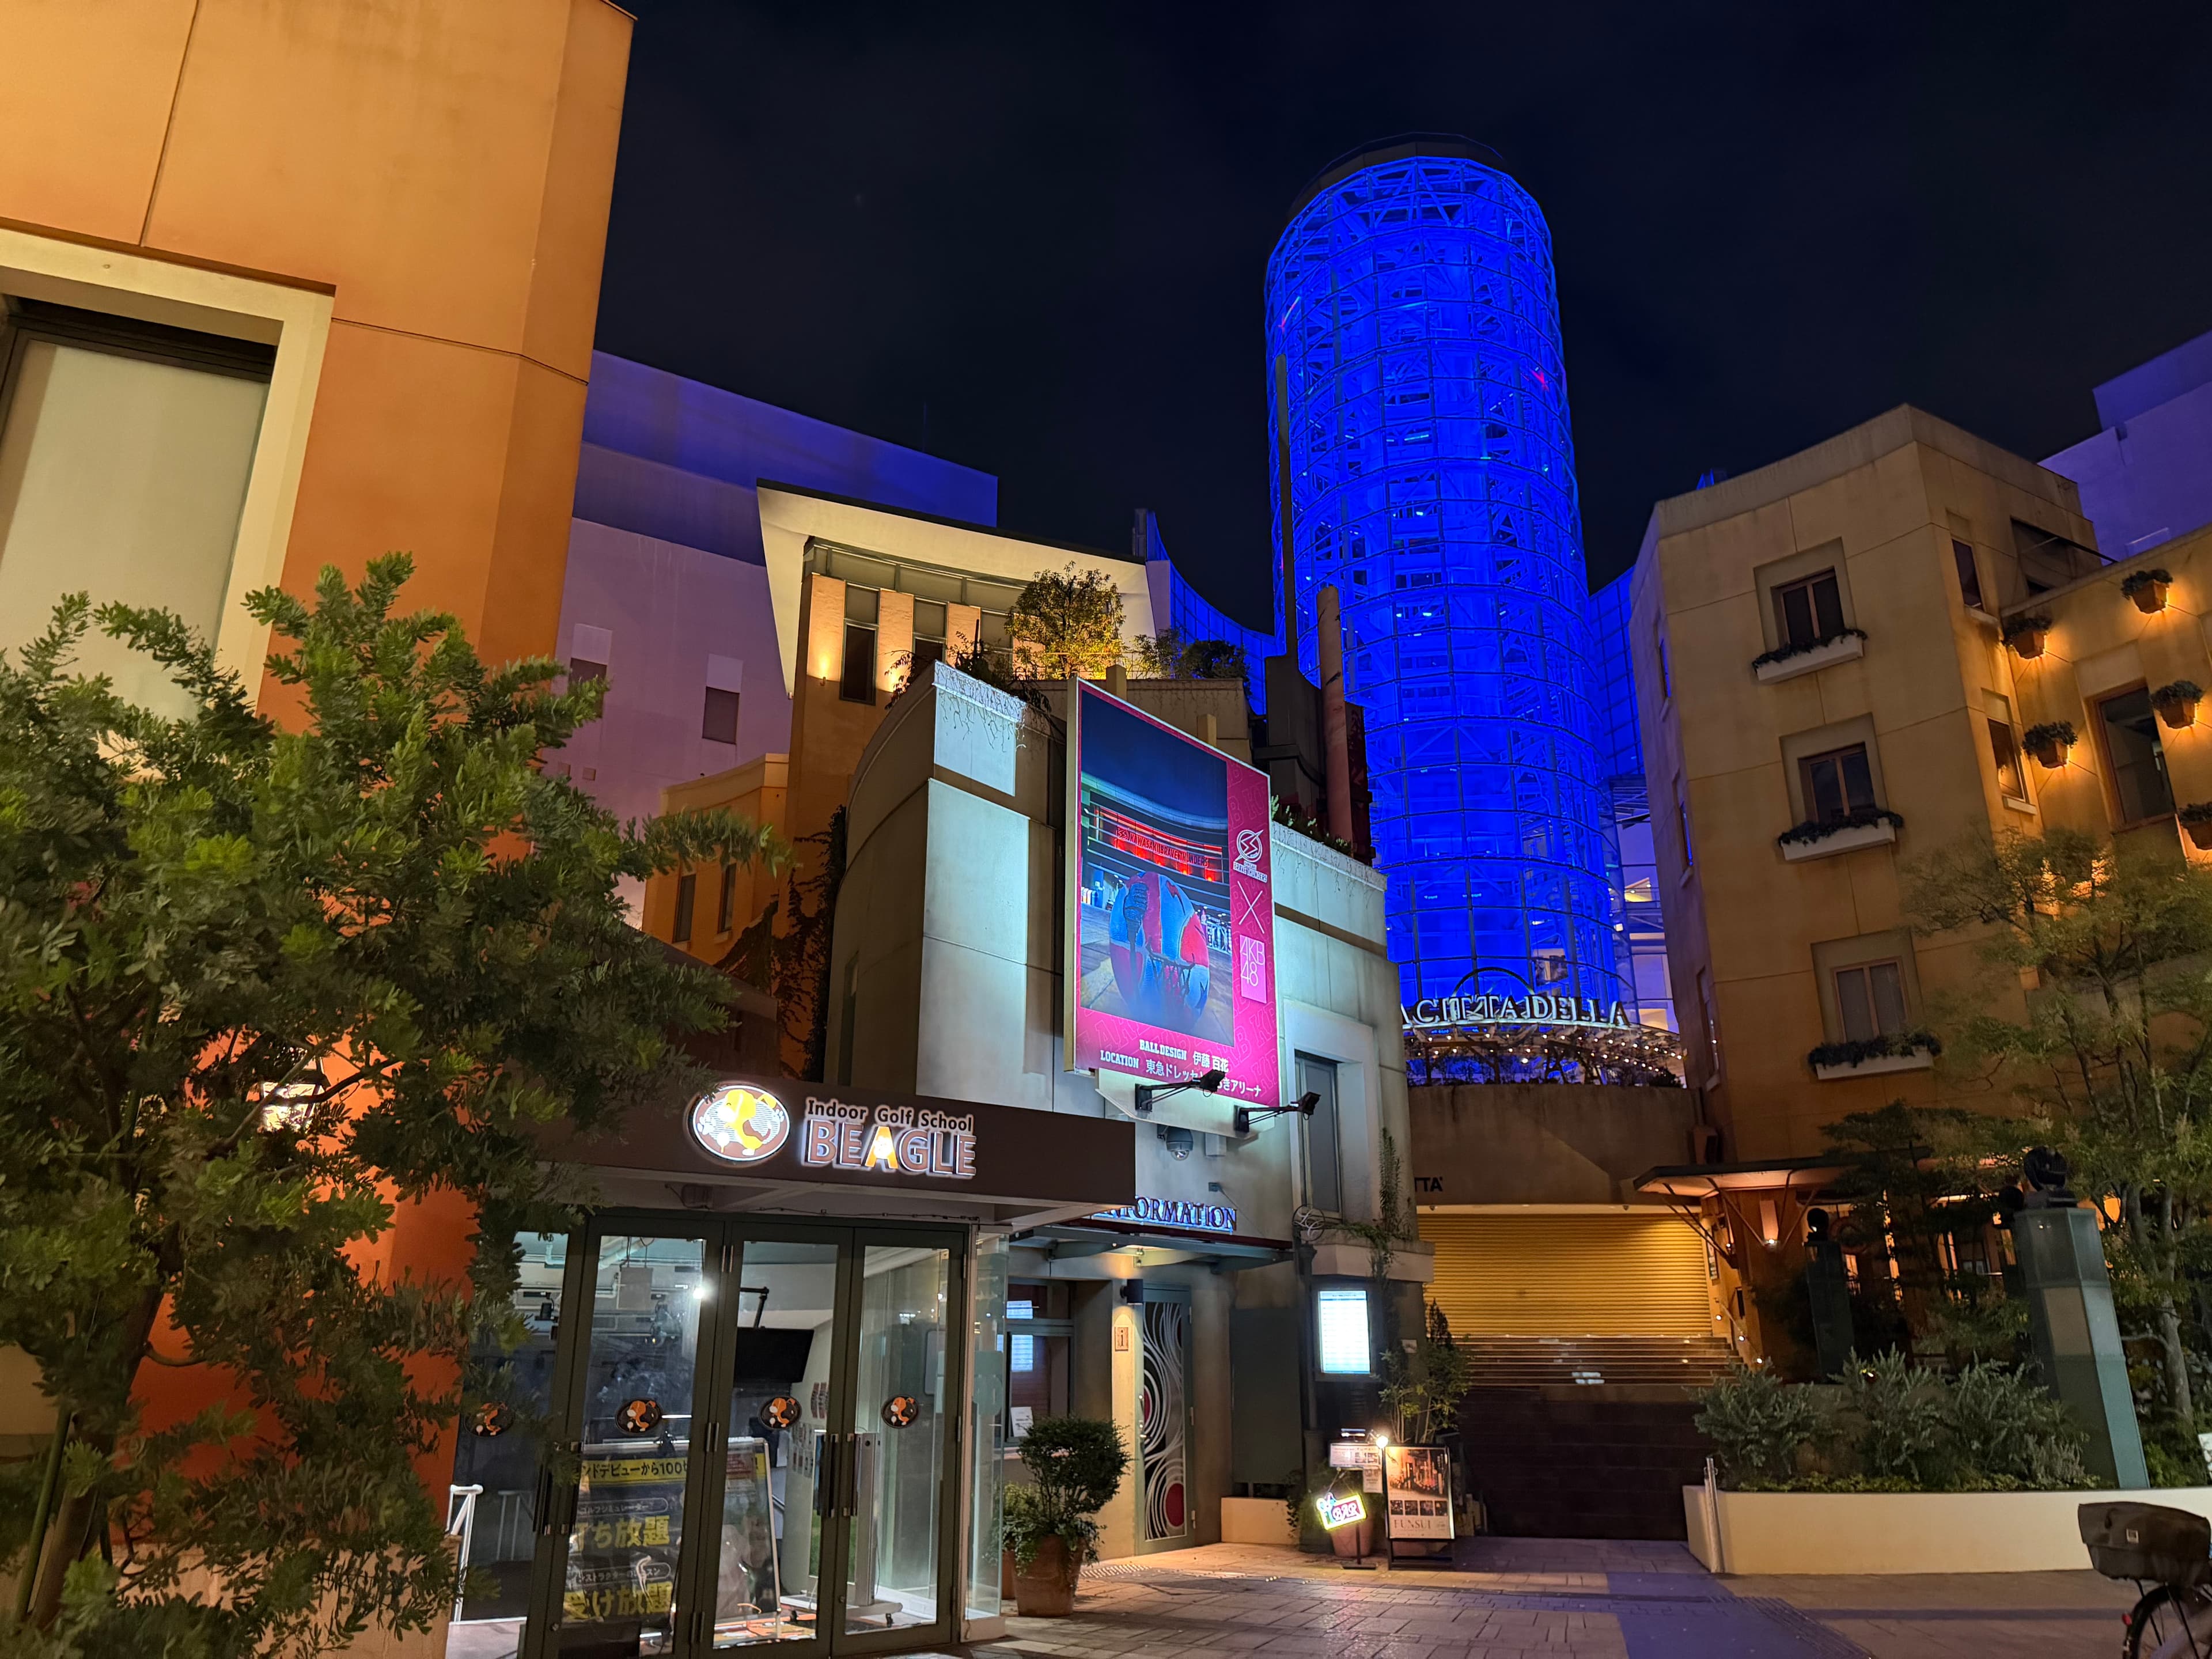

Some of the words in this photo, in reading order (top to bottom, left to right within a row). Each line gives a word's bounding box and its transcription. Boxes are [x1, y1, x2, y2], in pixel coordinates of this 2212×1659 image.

[1240, 936, 1266, 965] AKB
[1240, 960, 1259, 987] 48
[1100, 1050, 1139, 1069] LOCATION
[1139, 1039, 1160, 1054] BALL
[1160, 1044, 1187, 1060] DESIGN
[808, 1100, 867, 1120] Indoor
[877, 1108, 912, 1125] Golf
[921, 1112, 972, 1132] School
[805, 1119, 977, 1176] BEAGLE
[1332, 1502, 1358, 1521] BAR
